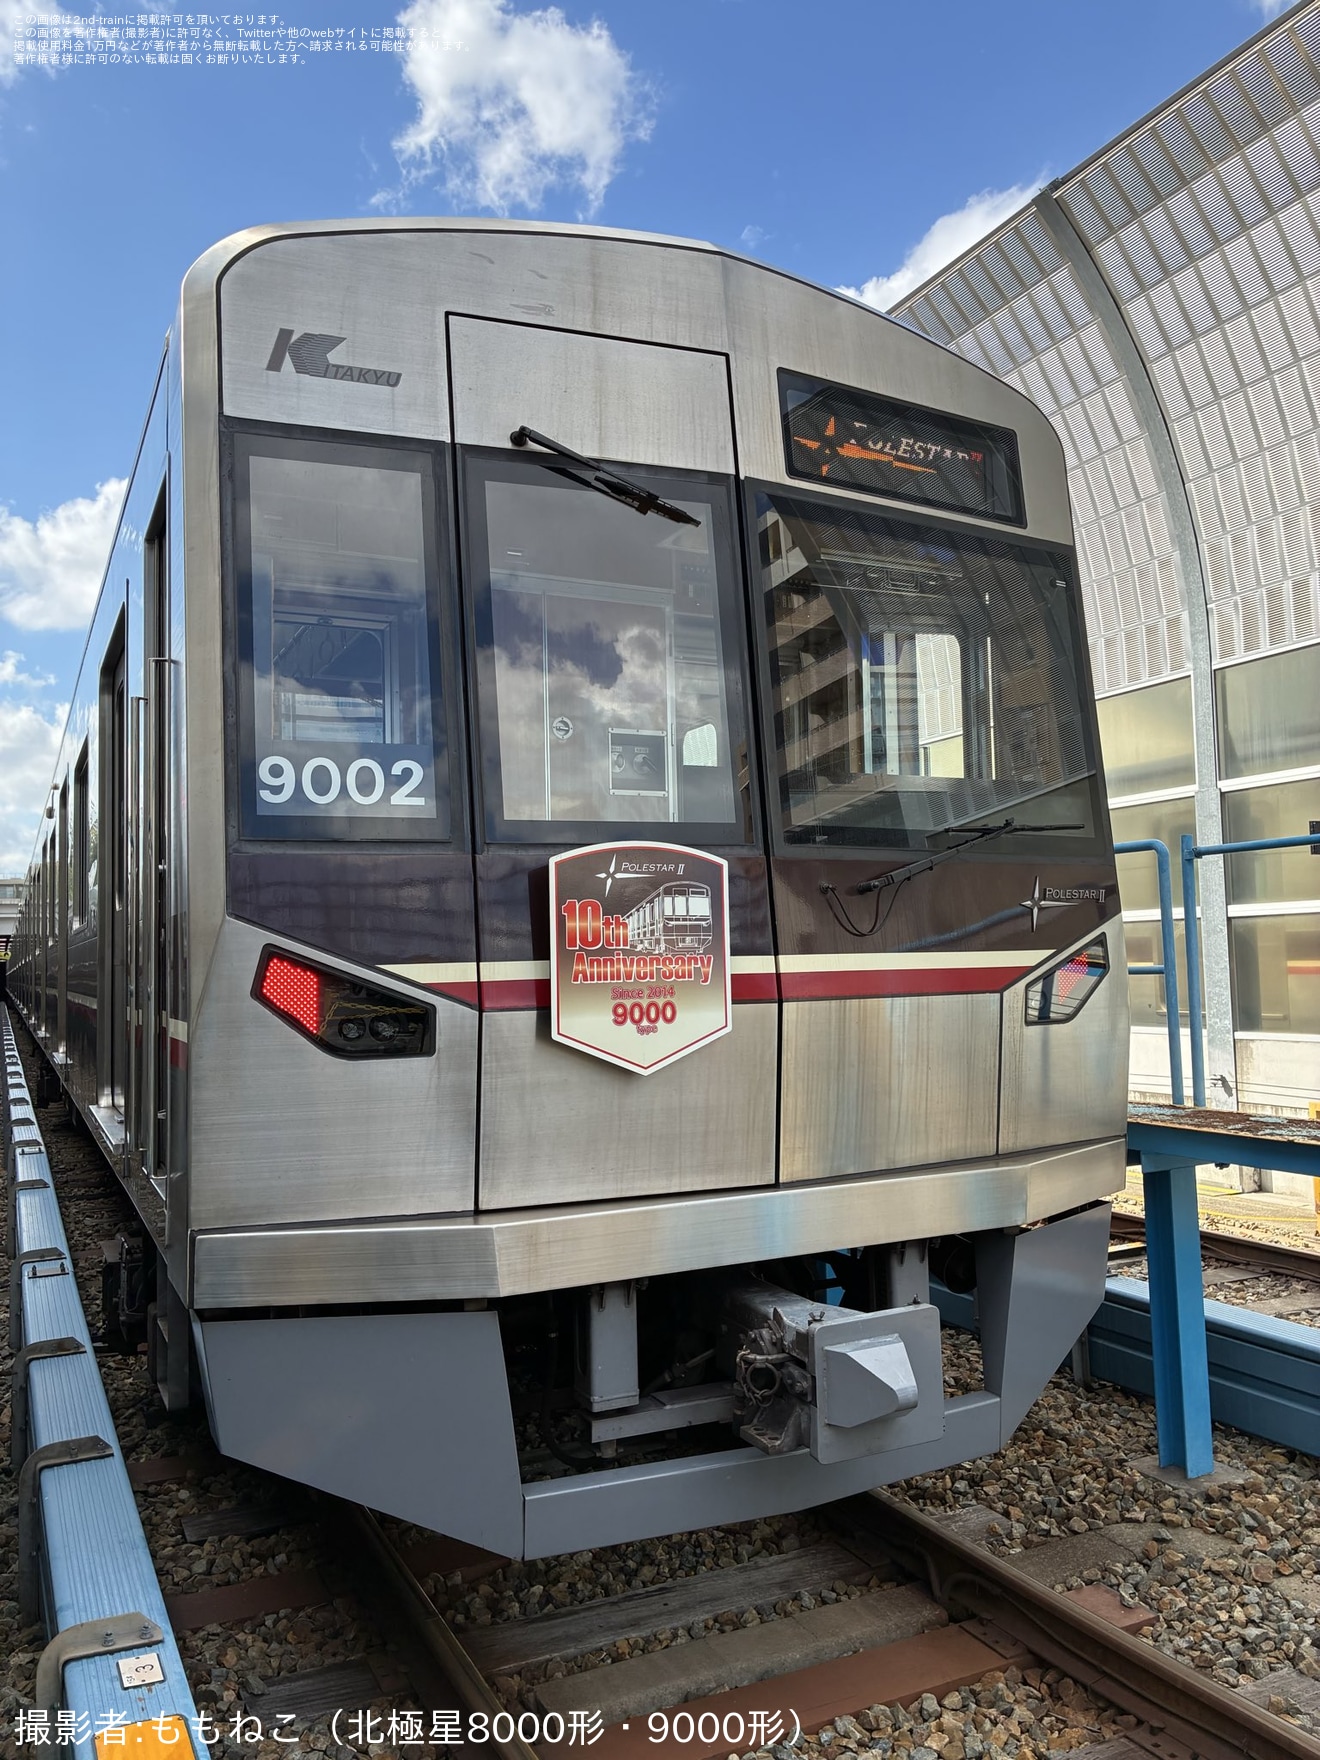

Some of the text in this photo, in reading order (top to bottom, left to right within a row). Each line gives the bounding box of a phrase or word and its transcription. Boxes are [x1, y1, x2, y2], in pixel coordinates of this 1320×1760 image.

[258, 755, 426, 807] 9002
[621, 862, 675, 873] POLESTAR
[1045, 887, 1097, 899] POLESTAR
[562, 899, 629, 949] 10th
[571, 951, 713, 984] Anniversary
[611, 985, 676, 1000] Since 2014
[611, 1000, 677, 1026] 9000
